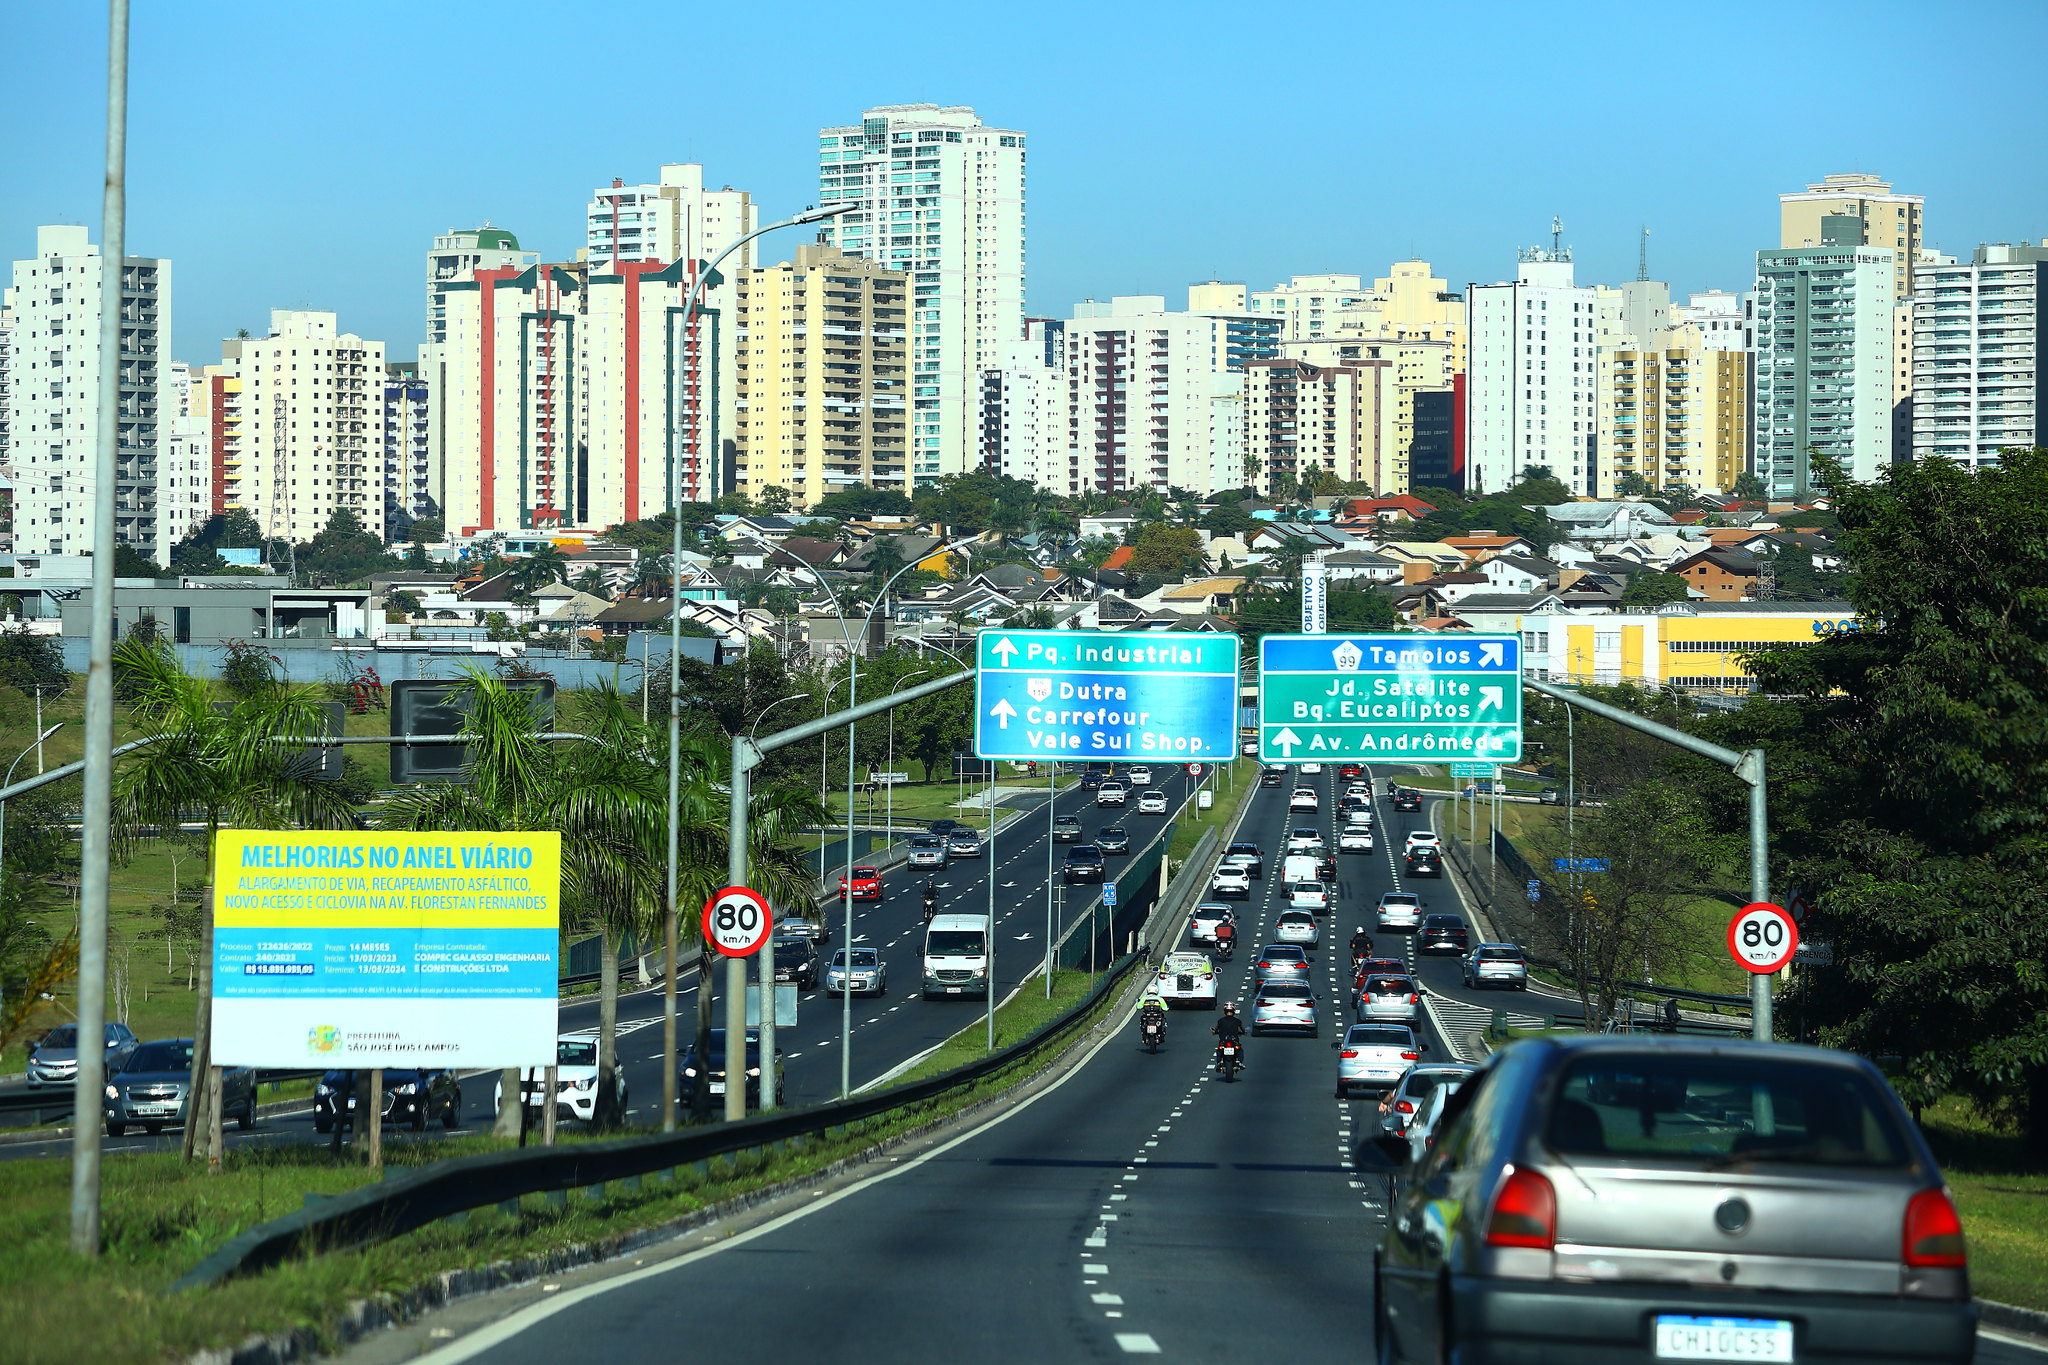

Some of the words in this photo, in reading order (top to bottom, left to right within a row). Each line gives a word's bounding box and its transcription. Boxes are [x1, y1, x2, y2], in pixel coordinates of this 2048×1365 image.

[1304, 576, 1313, 632] OBJETIVO
[1027, 643, 1067, 665] Pq.
[1076, 644, 1202, 664] Industrial
[1339, 655, 1356, 668] 99
[1369, 646, 1471, 664] Tamoios
[1032, 688, 1047, 697] 116
[1059, 681, 1127, 701] Dutra
[1325, 678, 1364, 697] Jd.
[1373, 678, 1471, 696] Satélite
[1026, 706, 1150, 726] Carrefour
[1293, 700, 1332, 722] Bq.
[1340, 700, 1470, 722] Eucaliptos
[1026, 730, 1082, 749] Vale
[1091, 731, 1131, 750] Sul
[1141, 731, 1211, 755] Shop.
[1308, 733, 1350, 751] Av.
[1360, 732, 1503, 751] Andrômeda
[241, 845, 365, 868] MELHORIAS
[368, 846, 400, 869] NO
[402, 846, 457, 869] ANEL
[460, 842, 533, 869] VIÁRIO
[238, 876, 327, 891] ALARGAMENTO
[329, 877, 344, 891] DE
[347, 877, 369, 893] VIA,
[372, 877, 465, 891] RECAPEAMENTO
[467, 875, 532, 893] ASFÁLTICO,
[225, 895, 259, 909] NOVO
[261, 895, 304, 909] ACESSO
[307, 895, 313, 909] E
[315, 895, 367, 909] CICLOVIA
[369, 896, 387, 909] NA
[388, 896, 408, 910] AV.
[411, 896, 475, 910] FLORESTAN
[479, 896, 547, 910] FERNANDES
[717, 903, 758, 931] 80
[723, 935, 751, 944] km/h
[1743, 919, 1783, 947] 80
[349, 943, 360, 951] 14
[361, 943, 390, 951] MESES
[1749, 951, 1778, 960] km/h
[414, 953, 451, 962] COMPEC
[452, 953, 493, 962] GALASSO
[494, 953, 551, 962] ENGENHARIA
[245, 964, 256, 975] R$
[414, 964, 420, 973] E
[421, 963, 485, 975] CONSTRUÇÕES
[486, 964, 509, 973] LTDA
[347, 1031, 401, 1040] PREFEITURA
[347, 1042, 367, 1051] SÃO
[370, 1042, 393, 1051] JOSÉ
[395, 1043, 416, 1052] DOS
[418, 1043, 461, 1052] CAMPOS
